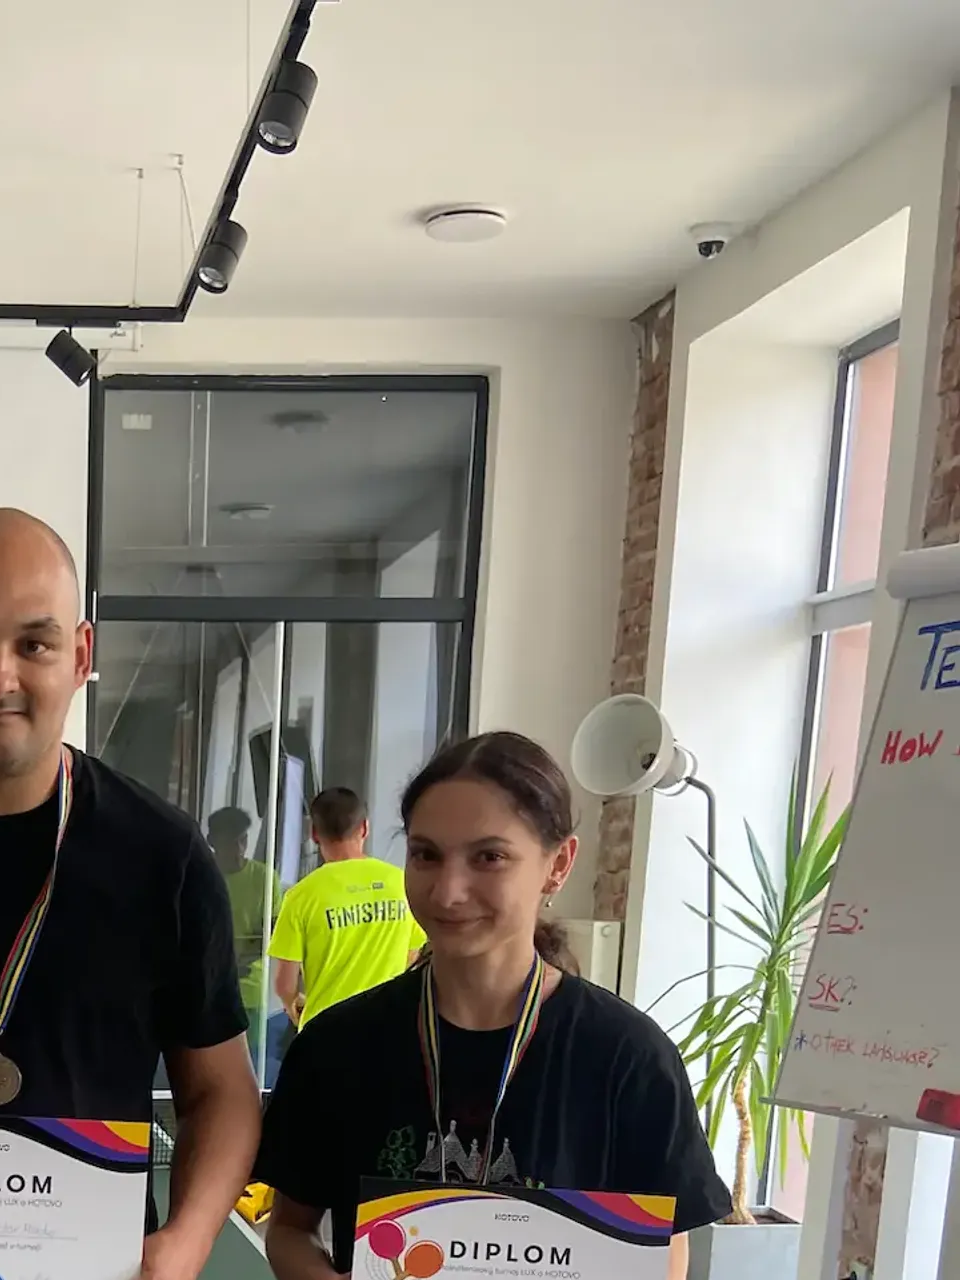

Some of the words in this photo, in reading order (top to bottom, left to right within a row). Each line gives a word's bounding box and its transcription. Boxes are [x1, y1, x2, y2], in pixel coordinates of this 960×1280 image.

[918, 620, 960, 690] TE
[881, 729, 944, 765] HOW
[494, 1212, 530, 1223] HOTOVO
[449, 1240, 572, 1266] DIPLOM
[520, 1269, 536, 1277] LUX
[545, 1271, 581, 1280] HOTOVO
